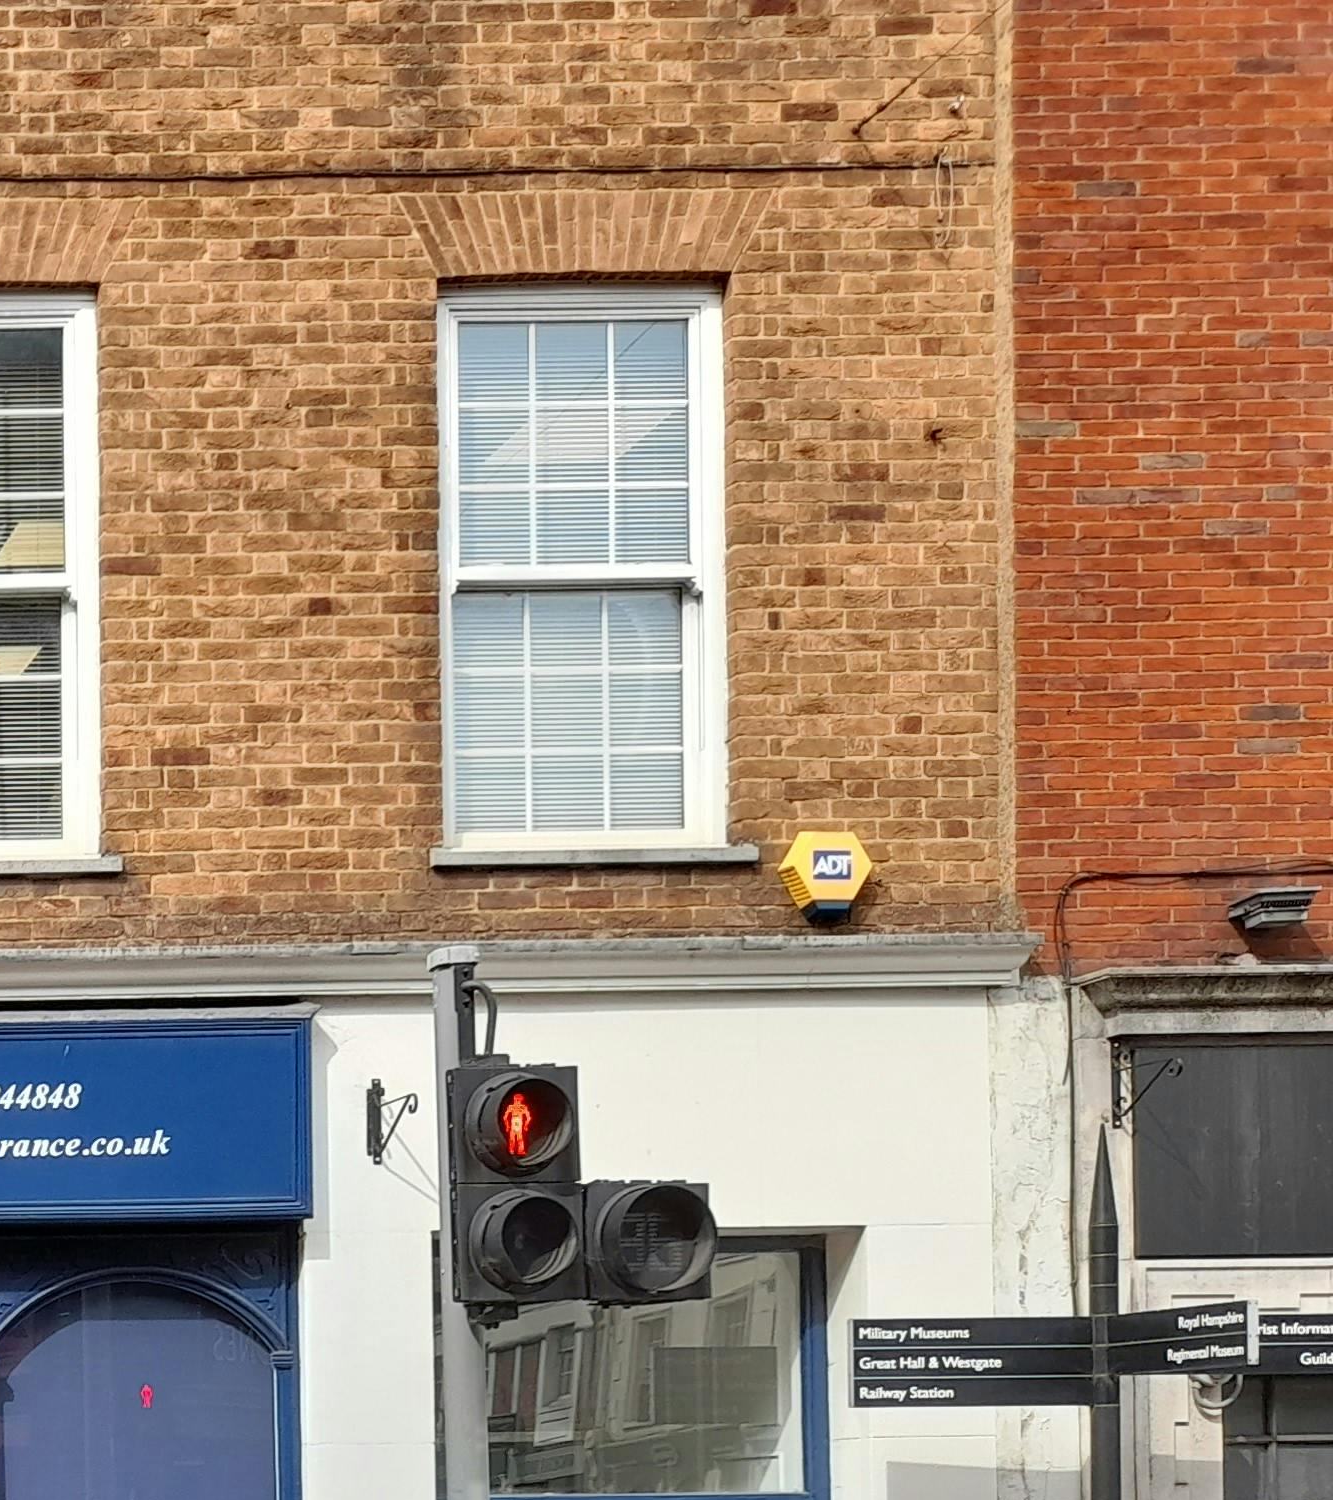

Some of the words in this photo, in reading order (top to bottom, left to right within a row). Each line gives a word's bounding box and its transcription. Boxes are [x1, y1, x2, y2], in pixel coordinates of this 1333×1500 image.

[812, 854, 853, 876] ADT
[1178, 1314, 1201, 1332] Royal
[1201, 1310, 1245, 1329] Hampshire
[858, 1327, 907, 1342] Military
[910, 1327, 970, 1340] Museums
[1210, 1344, 1245, 1358] Museum
[859, 1357, 897, 1370] Great
[899, 1356, 925, 1369] Hall
[928, 1357, 939, 1369] &
[942, 1356, 1003, 1371] Westgate
[859, 1387, 907, 1402] Railway
[909, 1387, 955, 1400] Station
